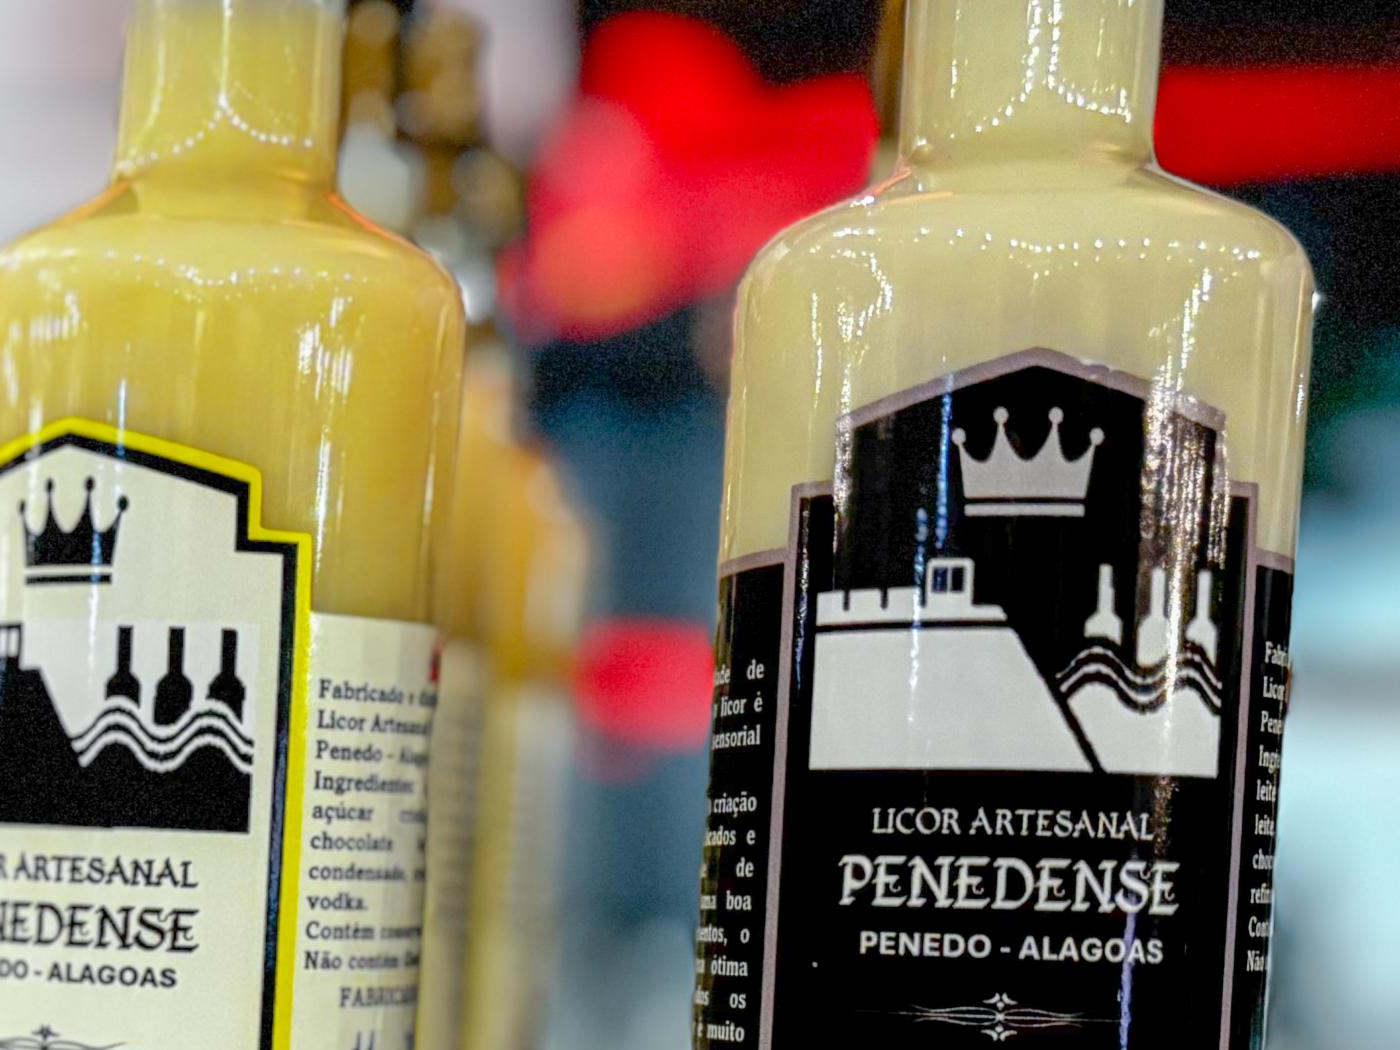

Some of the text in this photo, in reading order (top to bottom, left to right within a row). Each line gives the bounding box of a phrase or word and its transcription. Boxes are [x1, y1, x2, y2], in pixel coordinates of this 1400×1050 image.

[746, 659, 765, 680] de
[720, 695, 747, 717] licor
[753, 690, 764, 713] é
[316, 709, 366, 732] Licor
[315, 739, 383, 762] Penedo
[311, 801, 375, 825] açúcar
[713, 790, 758, 819] criação
[872, 806, 1156, 840] LICOR ARTESANAL
[746, 829, 756, 845] e
[13, 852, 199, 888] ARTESANAL
[735, 856, 755, 878] de
[838, 854, 1180, 916] PENEDENSE
[726, 888, 753, 911] boa
[740, 927, 750, 944] o
[859, 930, 992, 959] PENEDO
[1018, 935, 1164, 965] ALAGOAS
[303, 950, 343, 971] Não
[710, 953, 749, 978] ótima
[47, 960, 178, 989] ALAGOAS
[729, 991, 747, 1010] os
[706, 1019, 746, 1043] muito
